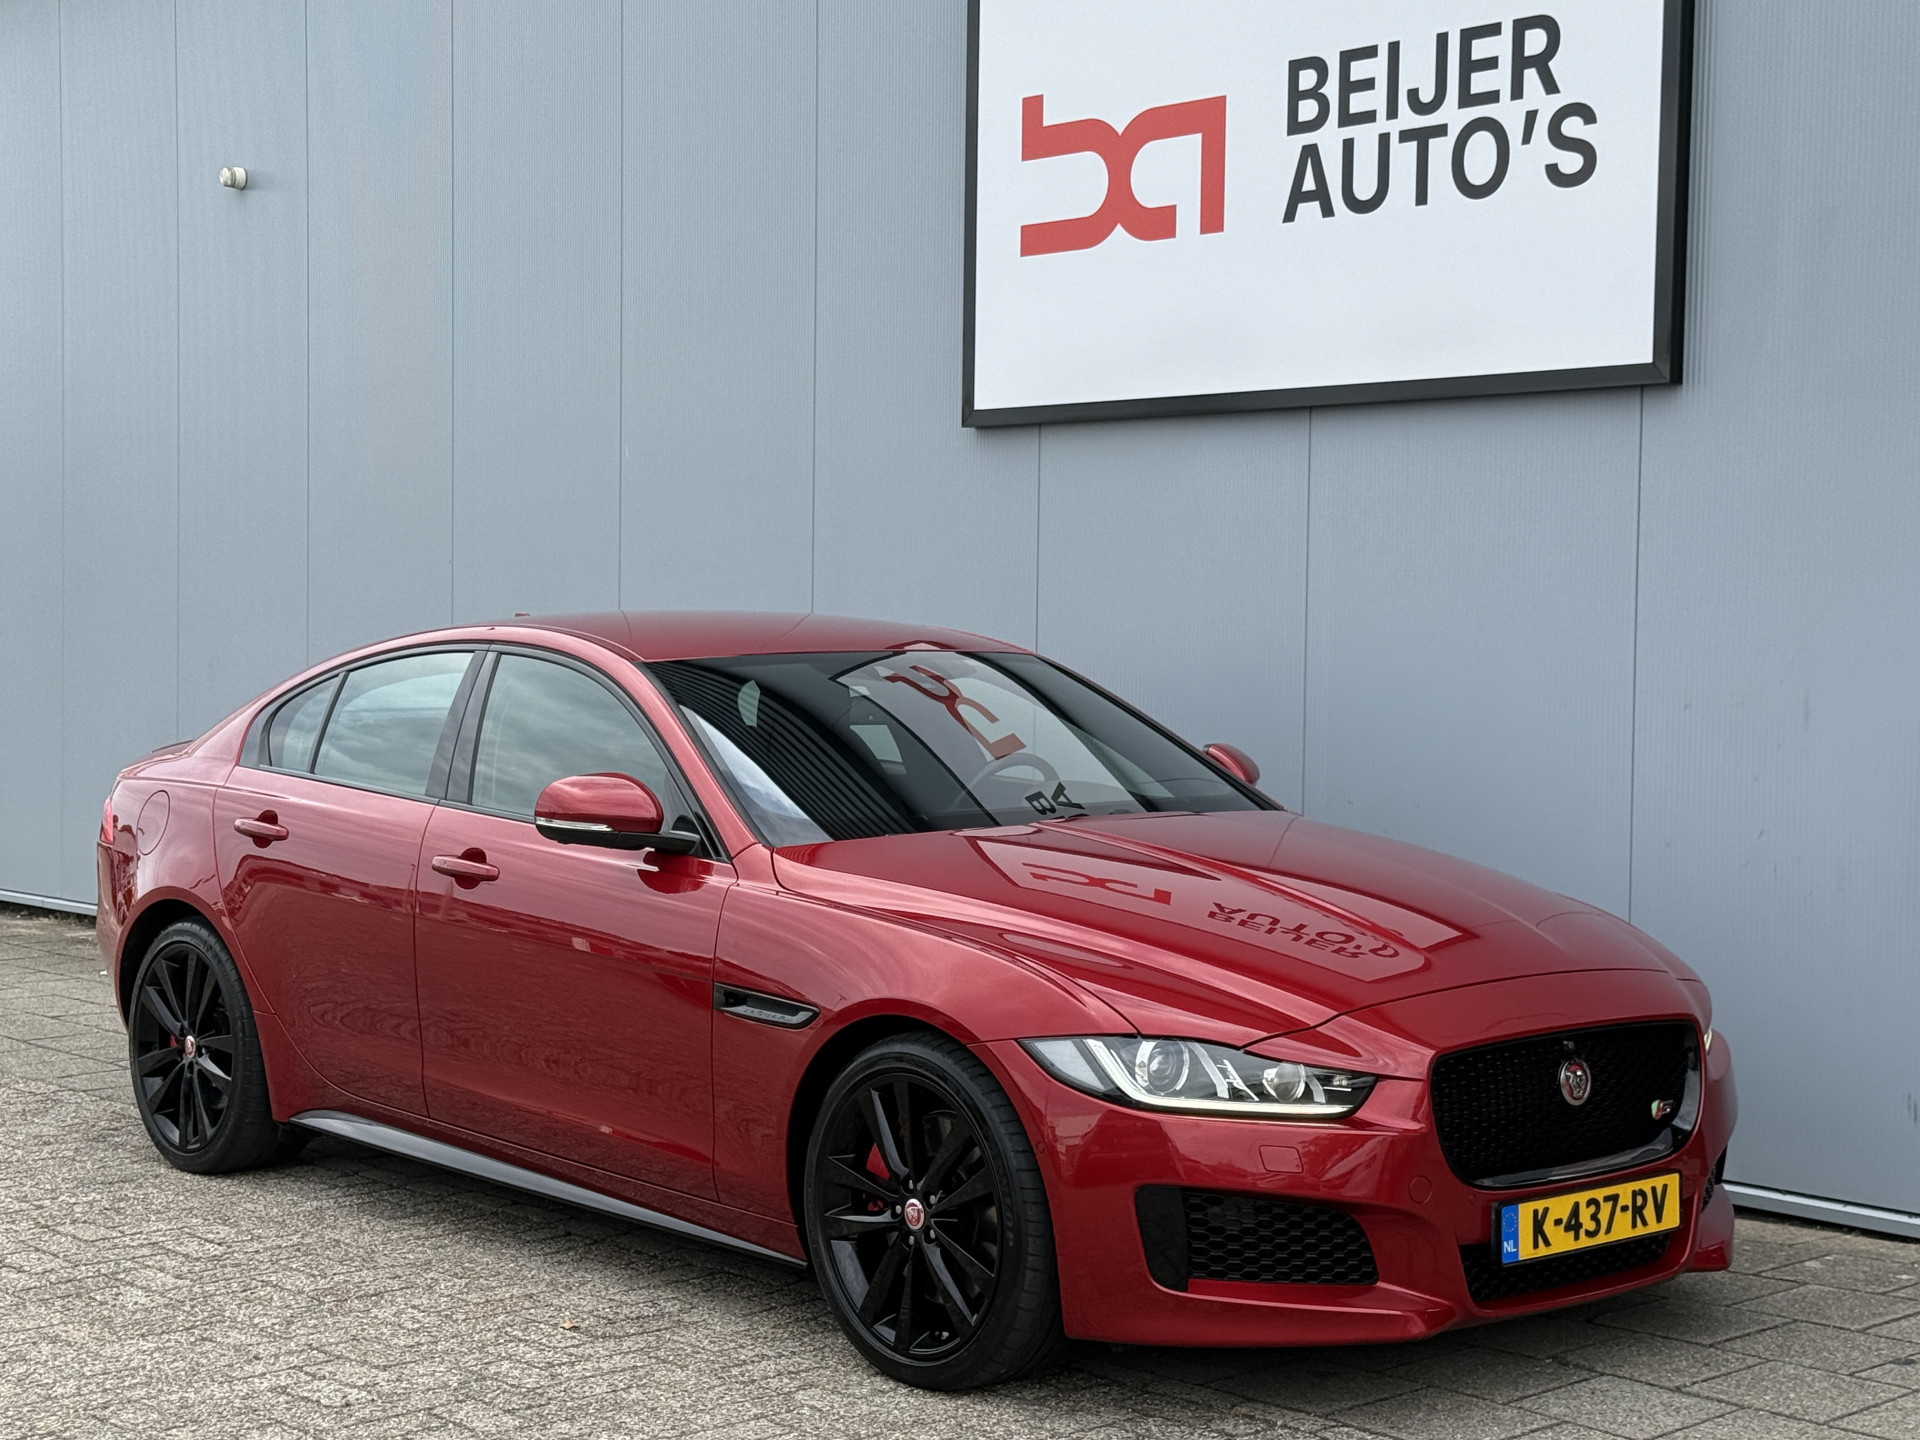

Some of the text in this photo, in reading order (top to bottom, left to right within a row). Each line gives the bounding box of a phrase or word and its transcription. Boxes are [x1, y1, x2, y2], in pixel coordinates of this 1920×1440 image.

[1286, 14, 1562, 137] BEIJER
[1282, 102, 1598, 224] AUTO'S
[1503, 1240, 1517, 1254] NL
[1532, 1183, 1668, 1250] K-437-RV
